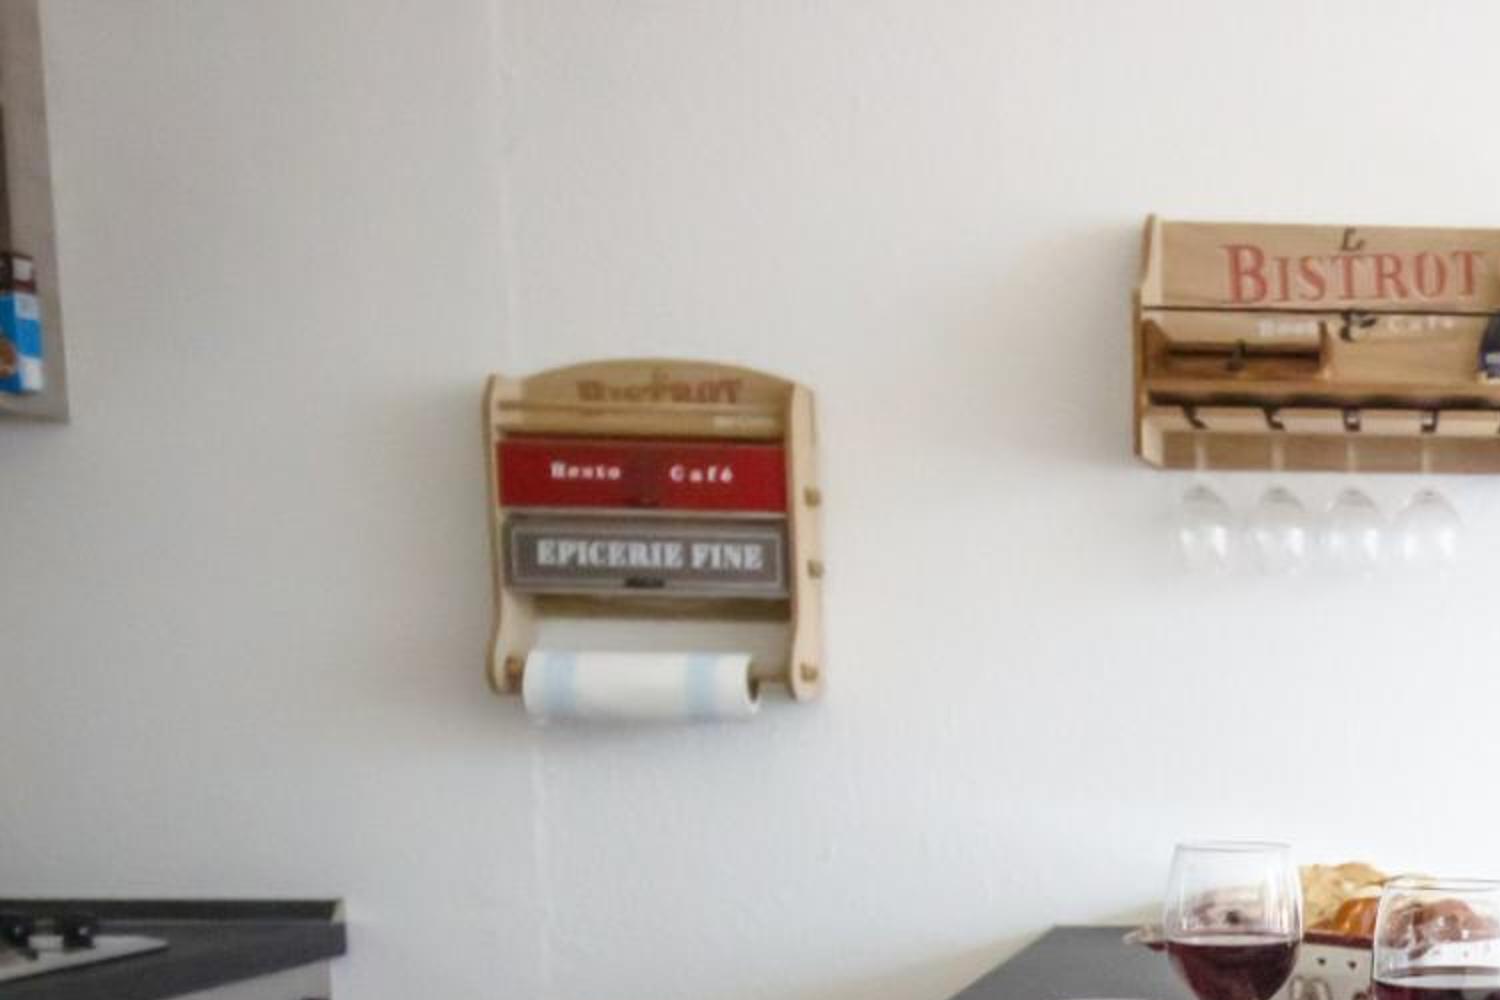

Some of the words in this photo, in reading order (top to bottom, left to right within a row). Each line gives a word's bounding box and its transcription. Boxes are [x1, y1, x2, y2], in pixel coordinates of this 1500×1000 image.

[1223, 244, 1486, 304] BISTROT
[669, 464, 734, 483] Café
[536, 539, 683, 569] EPICERIE
[692, 542, 764, 571] FINE
